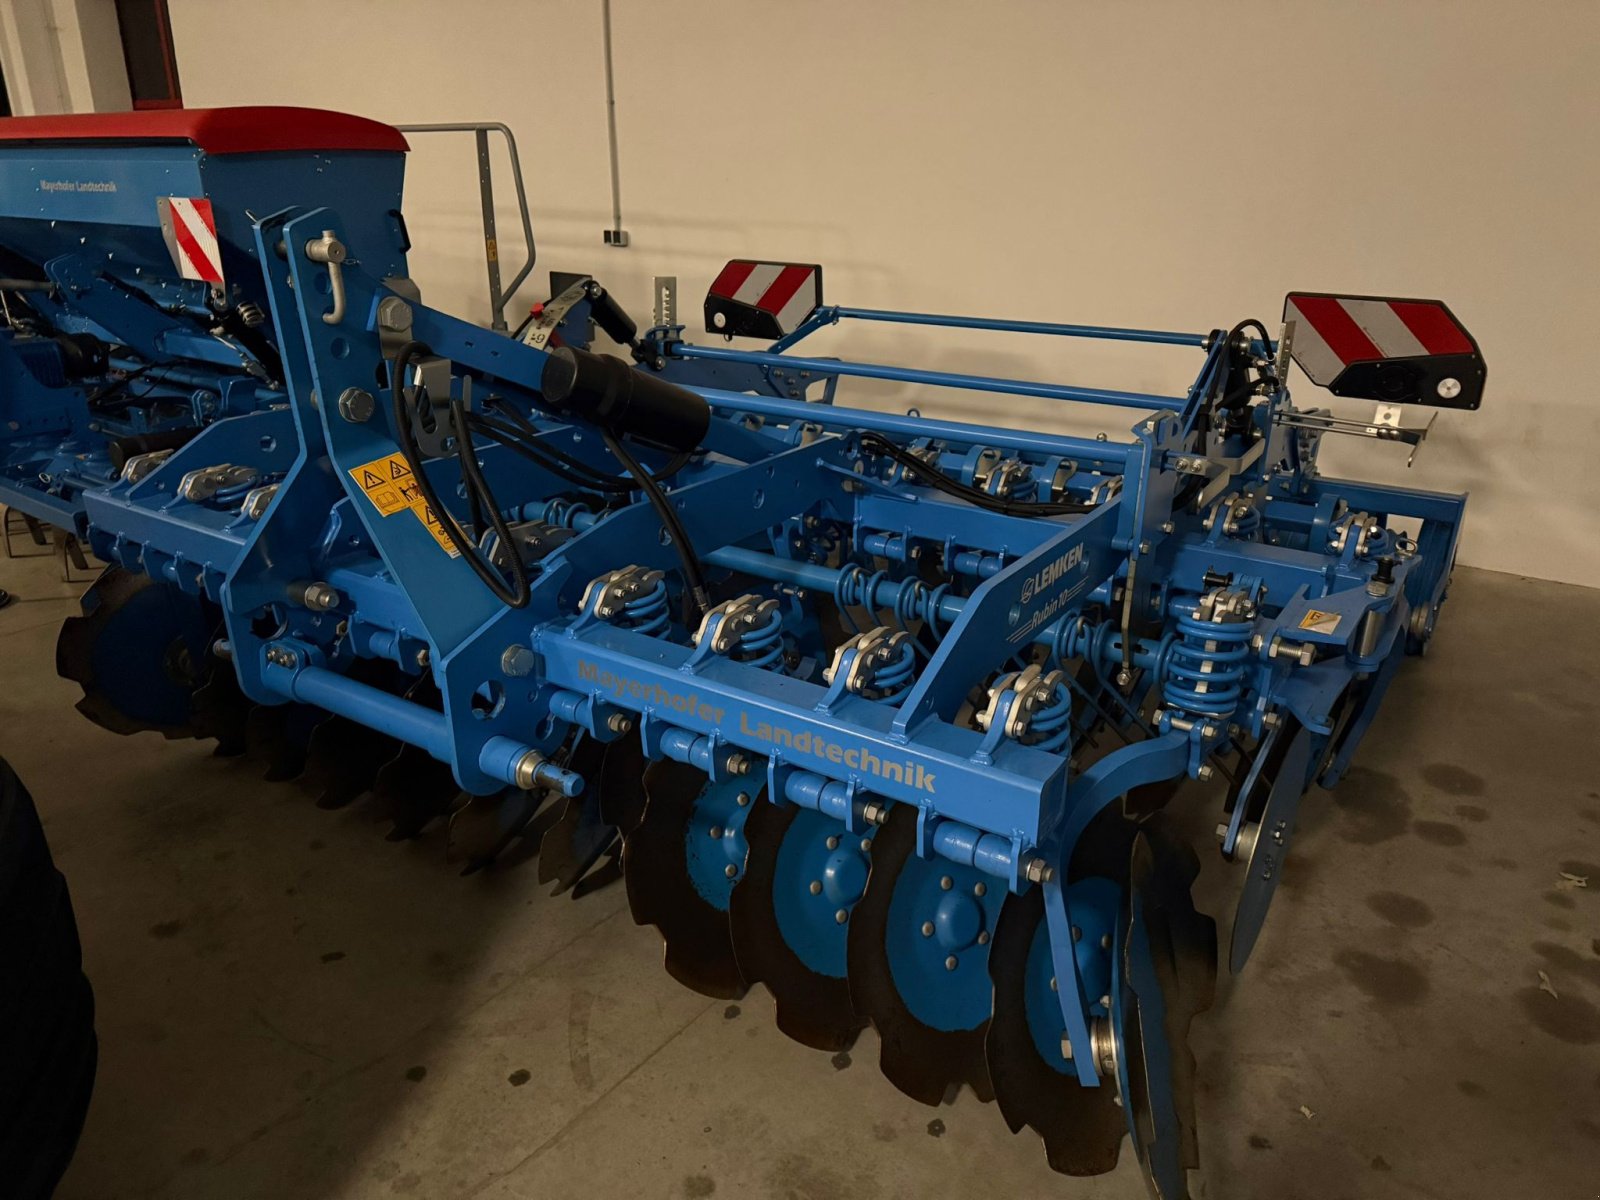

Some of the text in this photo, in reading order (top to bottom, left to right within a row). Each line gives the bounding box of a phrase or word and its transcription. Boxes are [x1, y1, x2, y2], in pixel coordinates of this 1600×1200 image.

[1034, 542, 1084, 595] LEMKEN
[1032, 589, 1069, 628] Rubin 10
[577, 659, 936, 794] Mayerhofer Landtechnik
